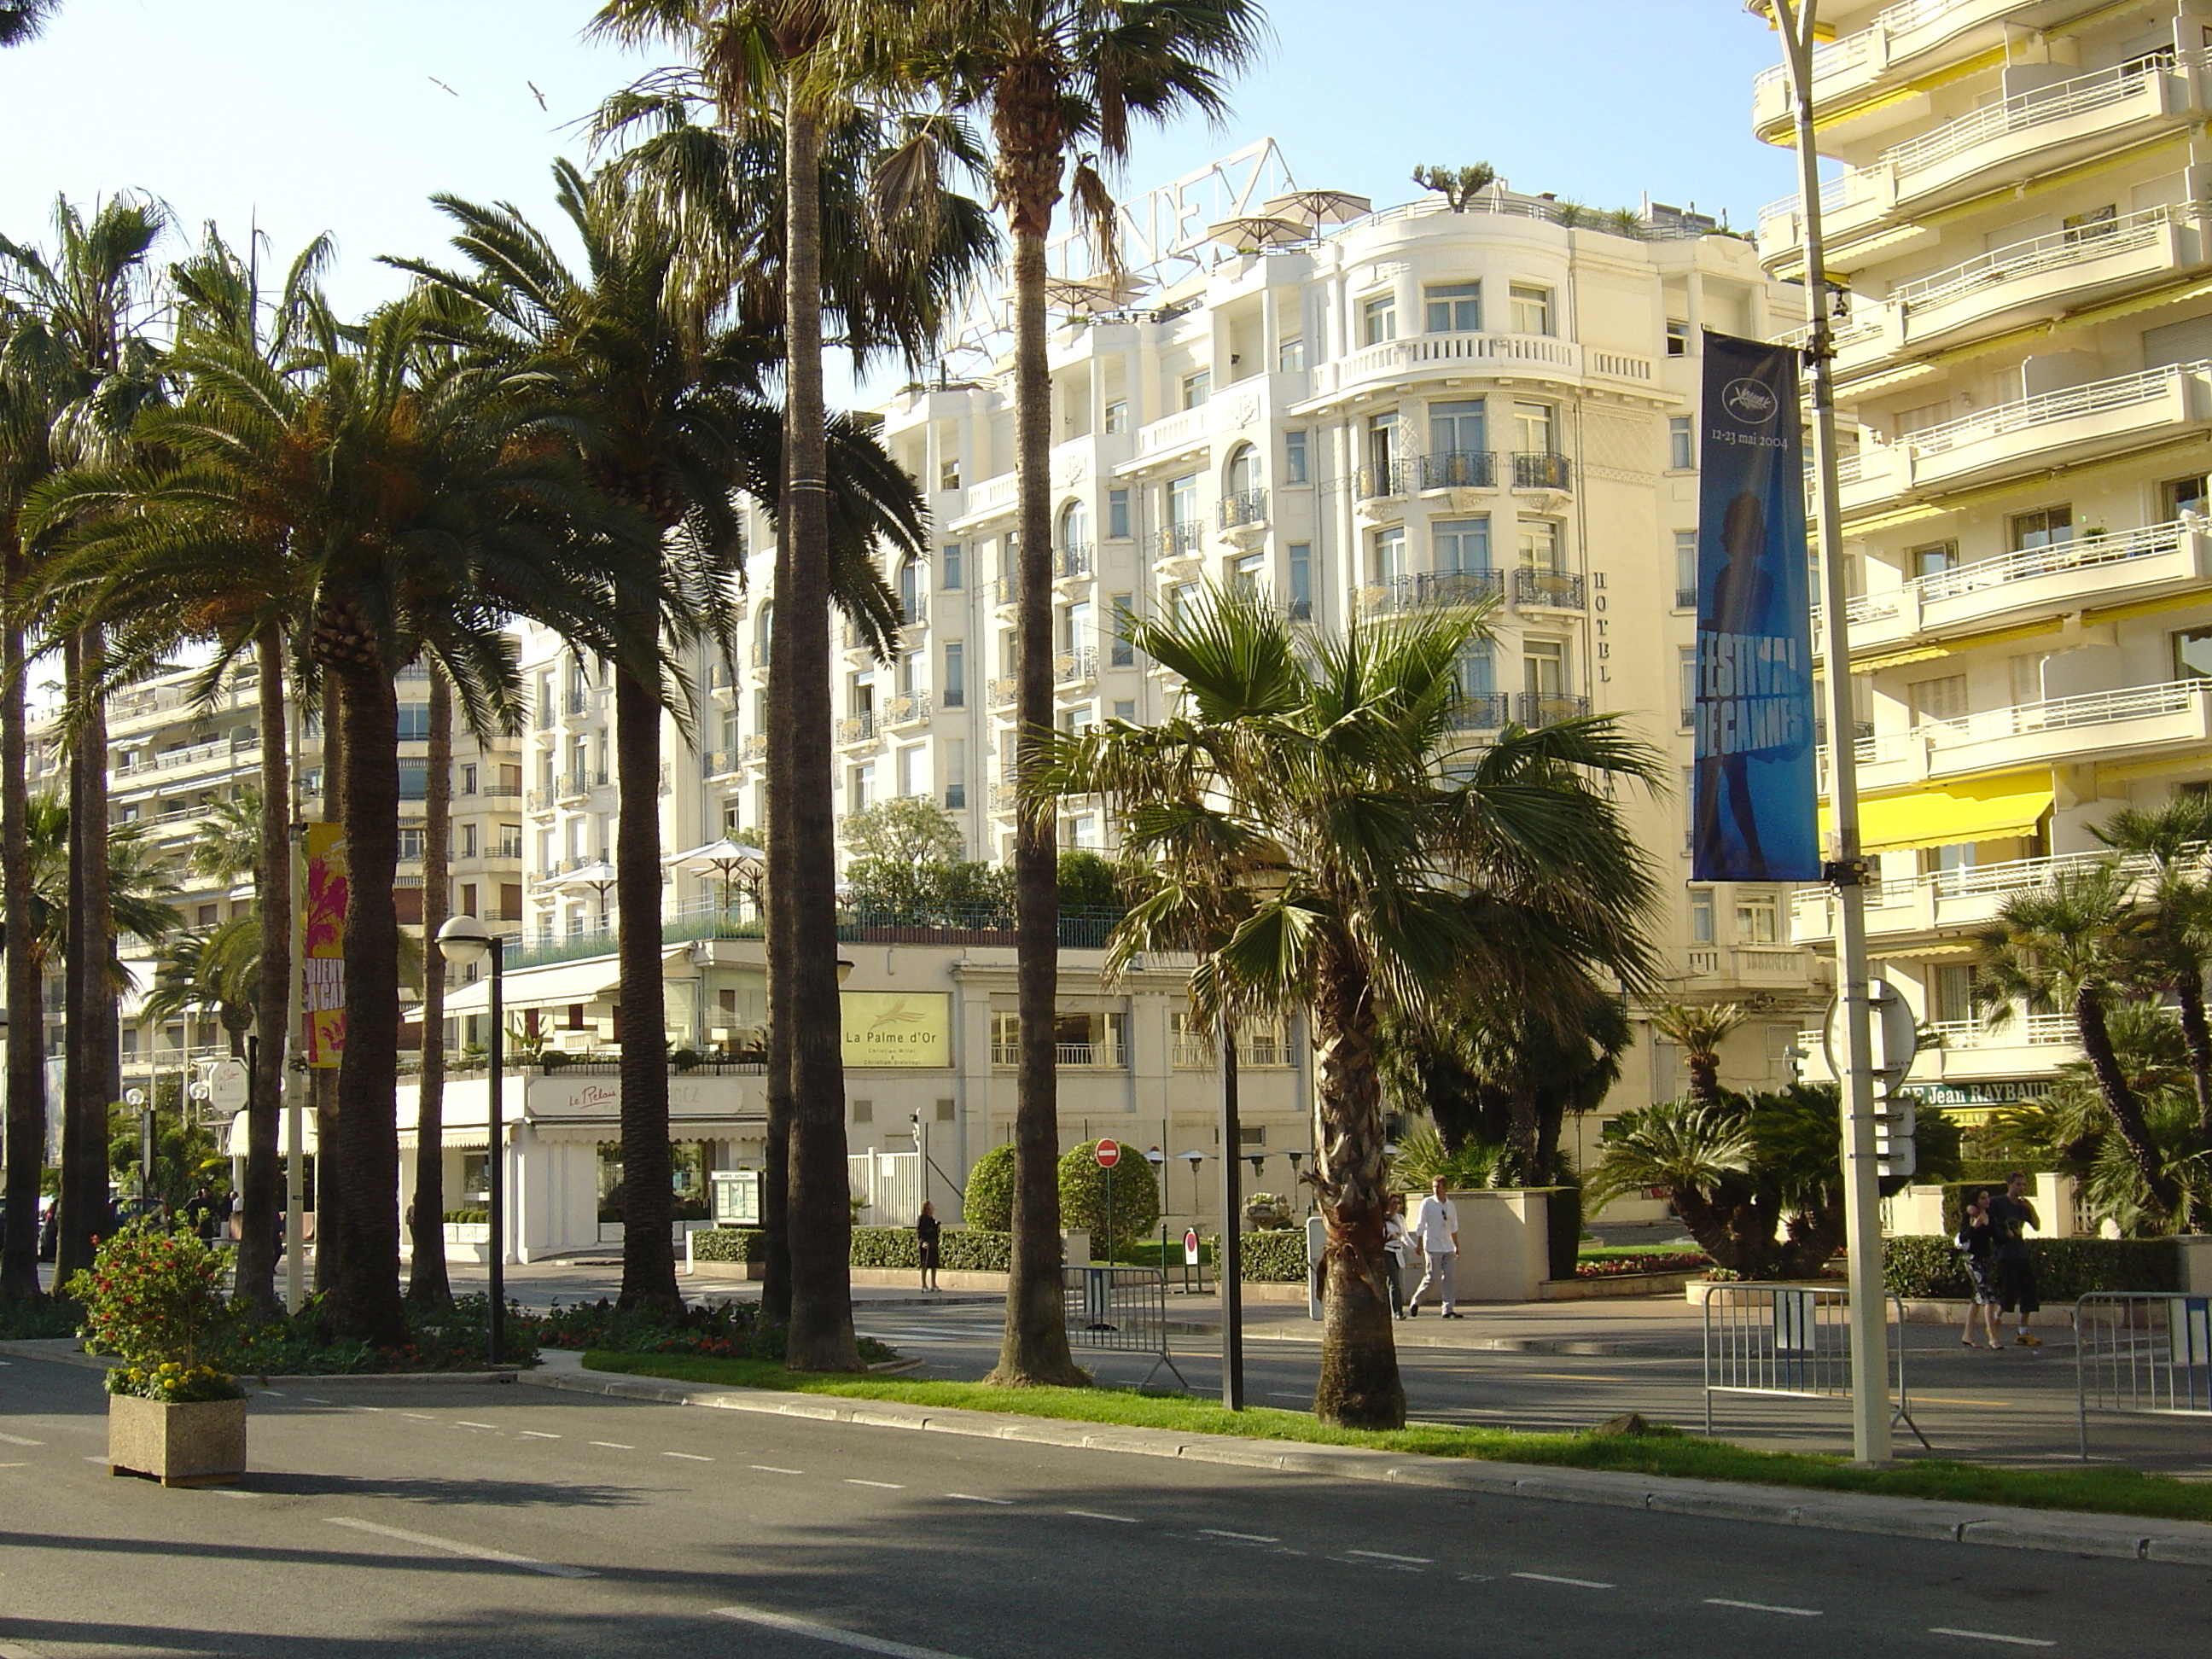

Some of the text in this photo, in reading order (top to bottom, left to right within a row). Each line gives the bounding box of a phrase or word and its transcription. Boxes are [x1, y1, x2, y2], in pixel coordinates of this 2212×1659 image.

[1712, 429, 1788, 451] 12-23 mai 2004
[1593, 572, 1611, 682] HOTEL
[1697, 630, 1800, 697] FESTIVAL
[1695, 697, 1803, 759] DE CANNES
[306, 958, 345, 983] BIENV
[320, 982, 346, 1011] CAN
[846, 1032, 936, 1043] La Palme d'Or
[569, 1086, 616, 1107] Le Relais
[1929, 1086, 1965, 1104] Jean
